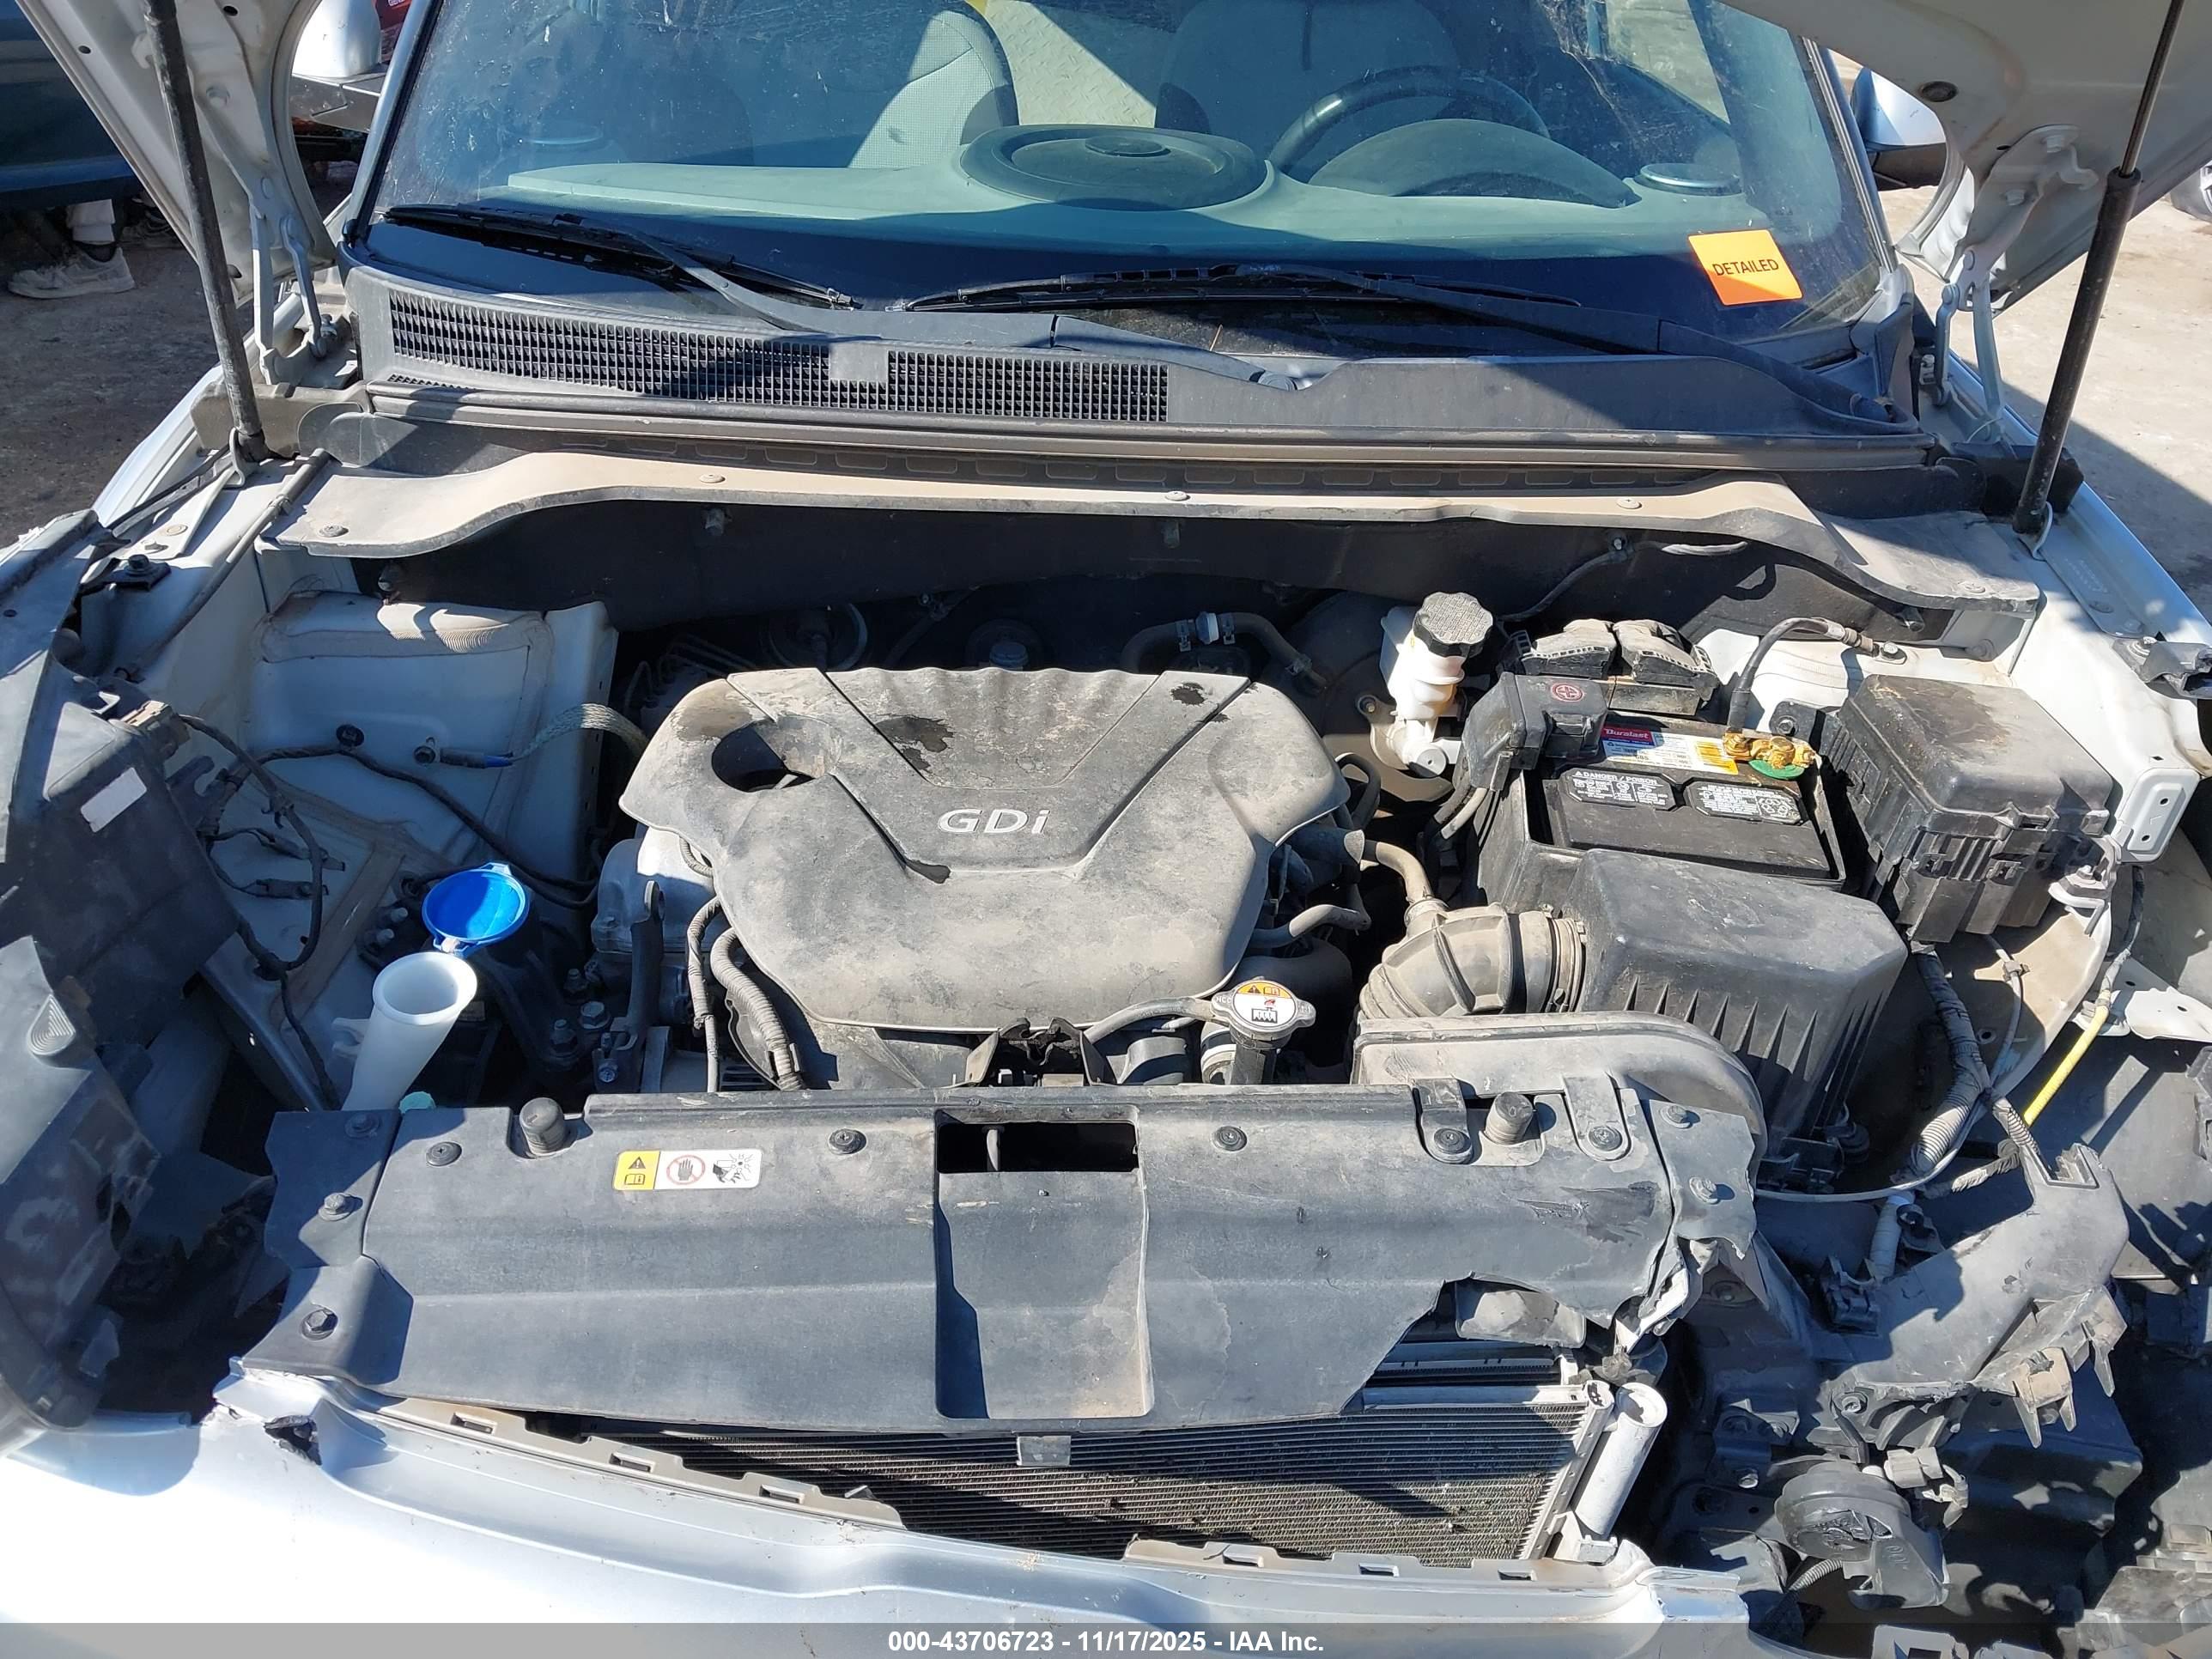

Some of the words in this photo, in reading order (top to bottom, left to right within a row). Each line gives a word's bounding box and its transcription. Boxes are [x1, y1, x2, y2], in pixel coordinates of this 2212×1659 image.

[1711, 258, 1780, 276] DETAILED
[1604, 727, 1650, 739] Duralast
[1583, 771, 1618, 781] DANGER
[1626, 775, 1658, 785] POISON
[937, 808, 1051, 834] GDi
